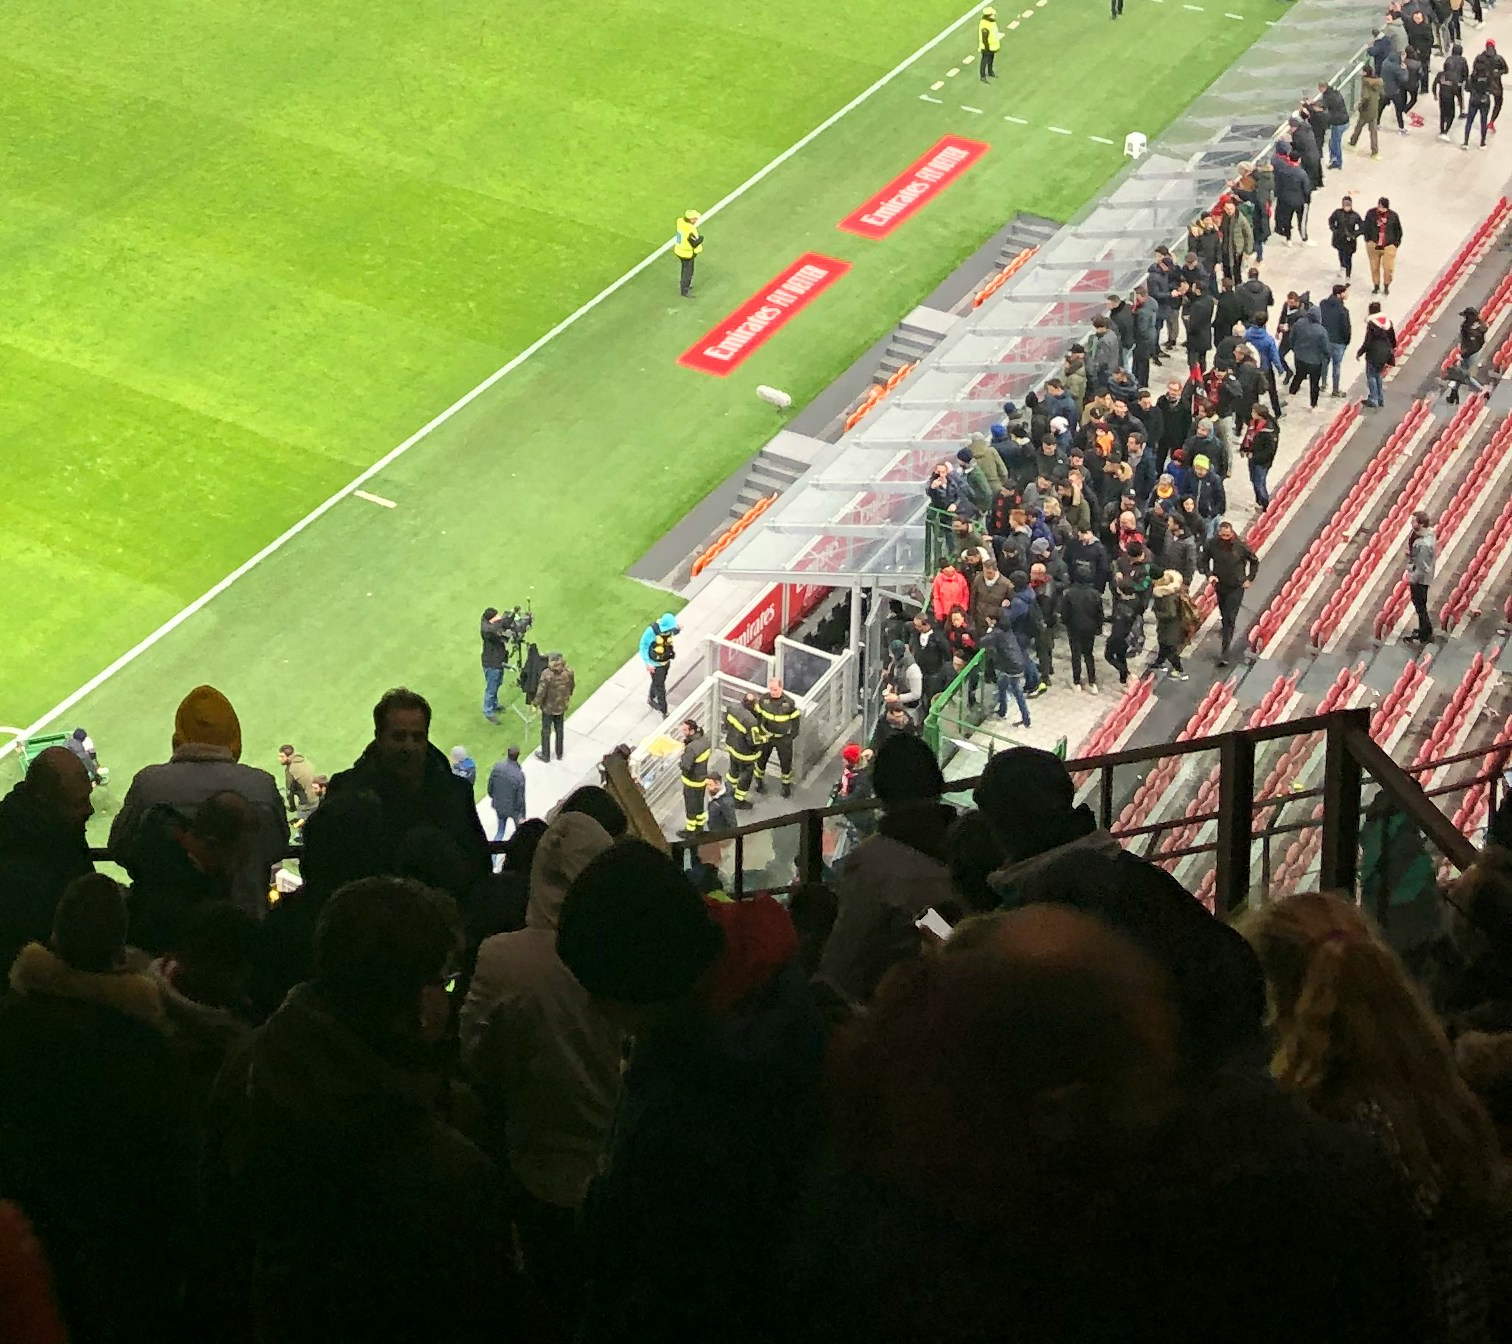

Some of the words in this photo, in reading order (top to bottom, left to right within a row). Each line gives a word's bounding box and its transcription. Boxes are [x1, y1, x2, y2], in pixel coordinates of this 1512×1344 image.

[859, 179, 930, 227] Emirates
[927, 145, 970, 172] BETTER
[765, 289, 798, 308] FLY
[781, 264, 830, 295] BETTER
[703, 304, 782, 362] Emirates
